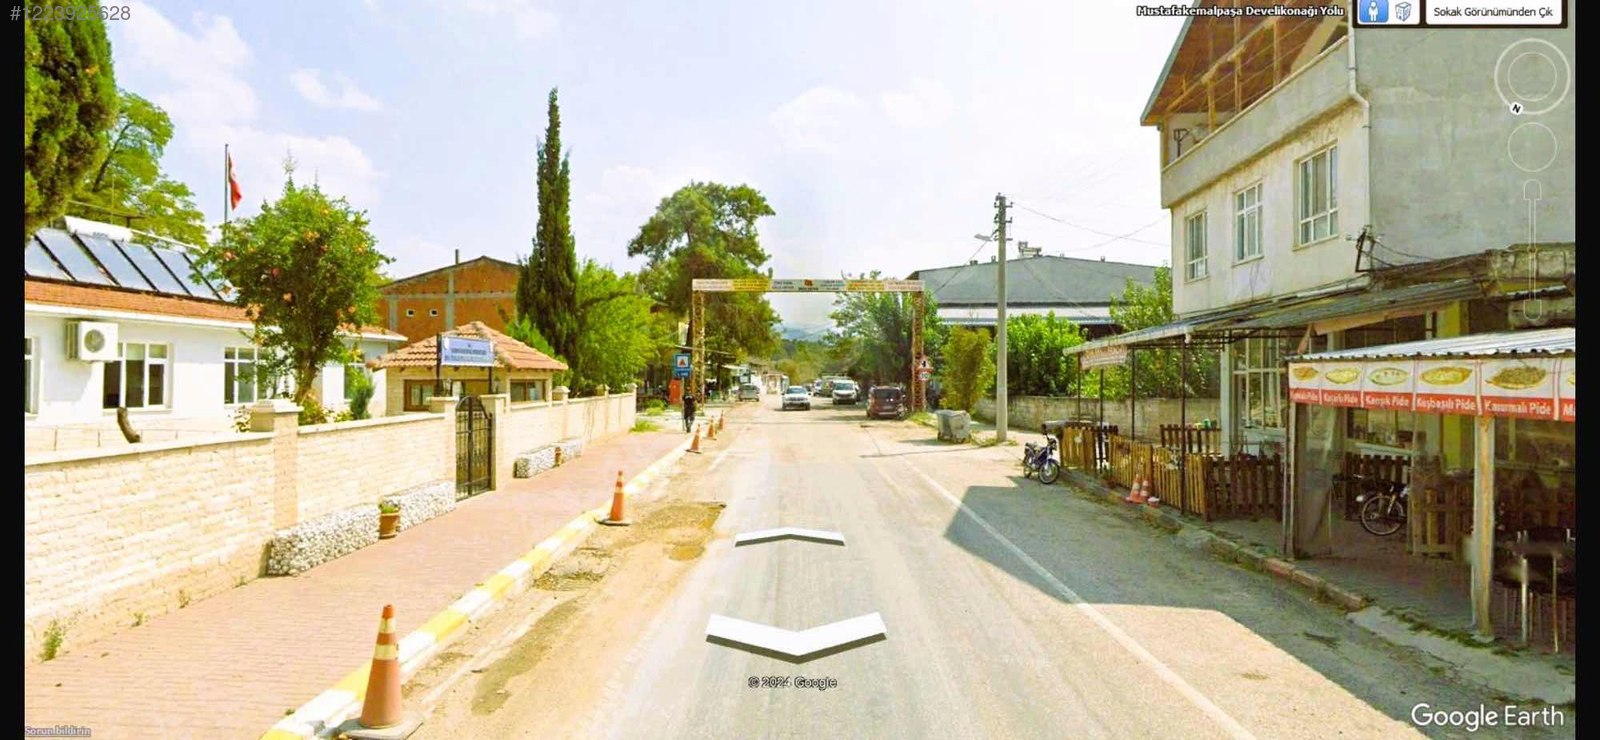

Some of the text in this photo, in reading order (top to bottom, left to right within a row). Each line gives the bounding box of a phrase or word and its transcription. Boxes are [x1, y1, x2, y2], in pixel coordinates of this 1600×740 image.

[1391, 396, 1409, 407] Pide
[1455, 399, 1476, 411] Pide
[1531, 402, 1552, 416] Pide
